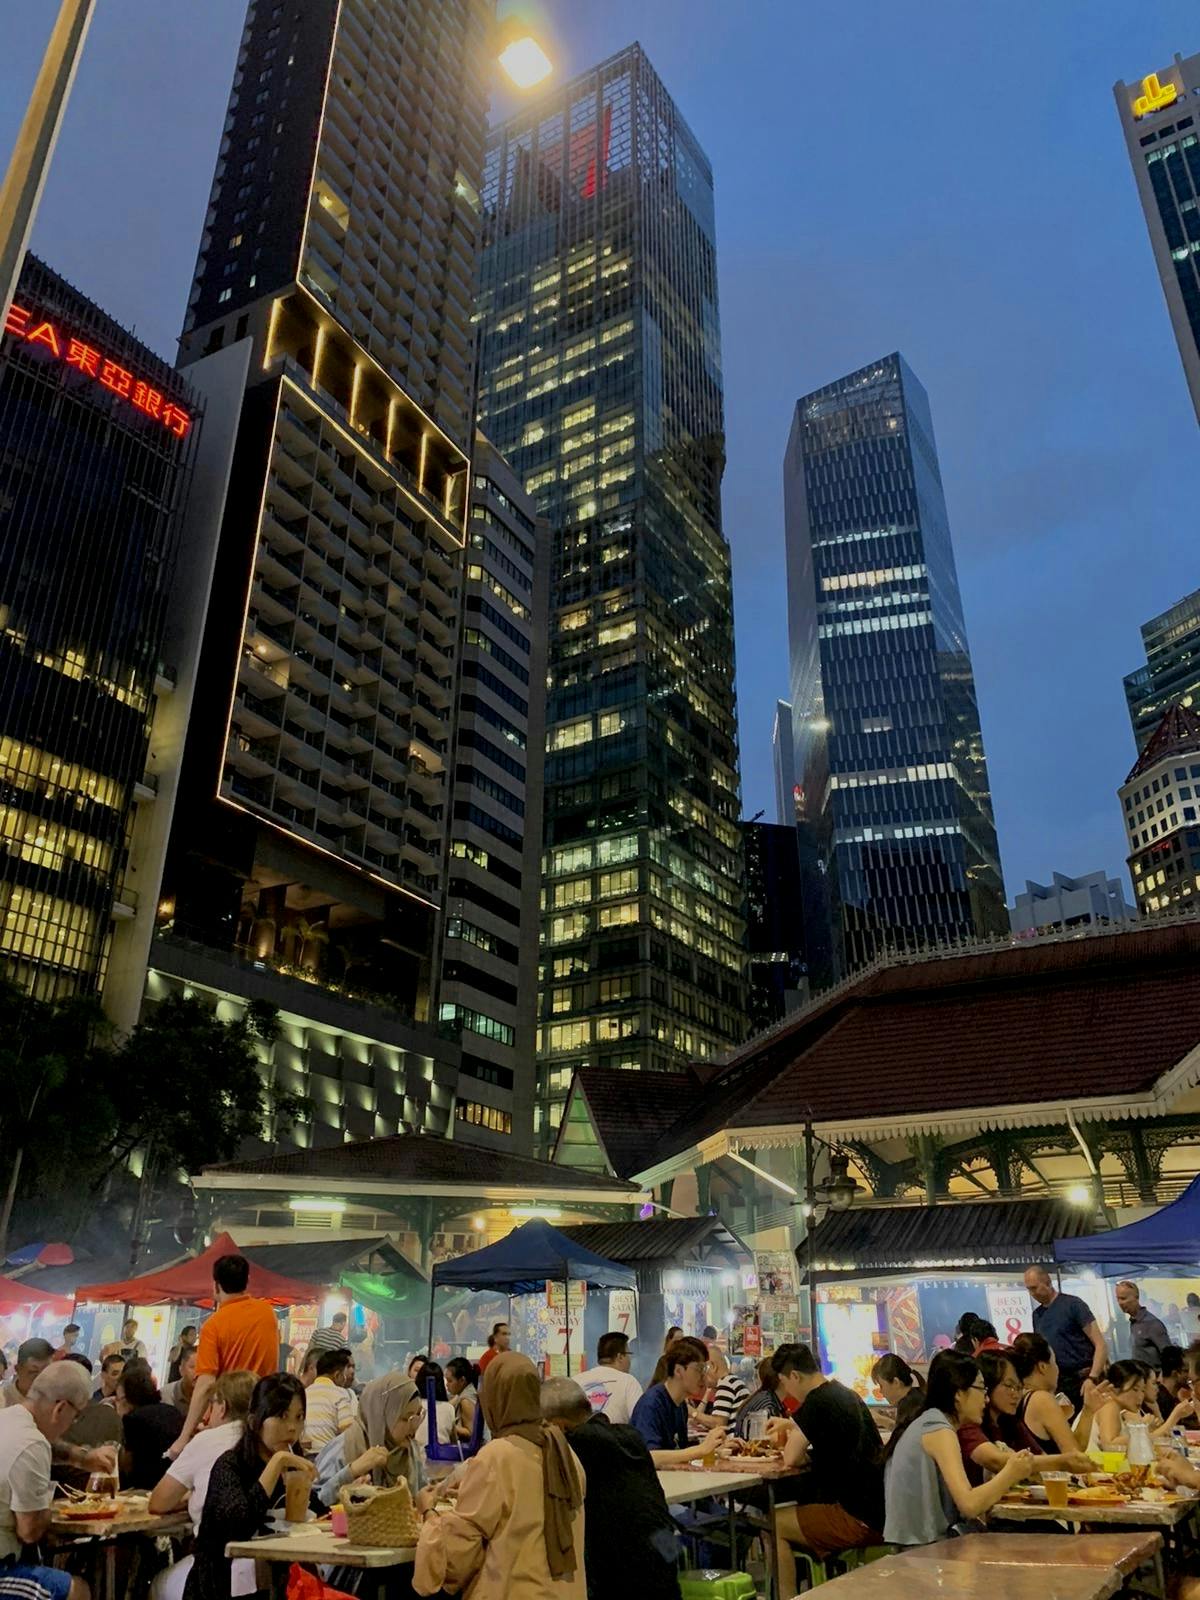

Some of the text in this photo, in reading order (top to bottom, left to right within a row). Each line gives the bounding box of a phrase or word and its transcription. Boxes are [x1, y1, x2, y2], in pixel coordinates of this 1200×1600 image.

[66, 337, 191, 436] 東亞銀行
[997, 1296, 1024, 1306] BEST
[553, 1307, 577, 1316] BEST
[994, 1306, 1028, 1316] SATAY
[549, 1317, 580, 1326] SATAY
[617, 1313, 630, 1333] 7
[1005, 1317, 1022, 1345] 8
[557, 1328, 573, 1354] 7
